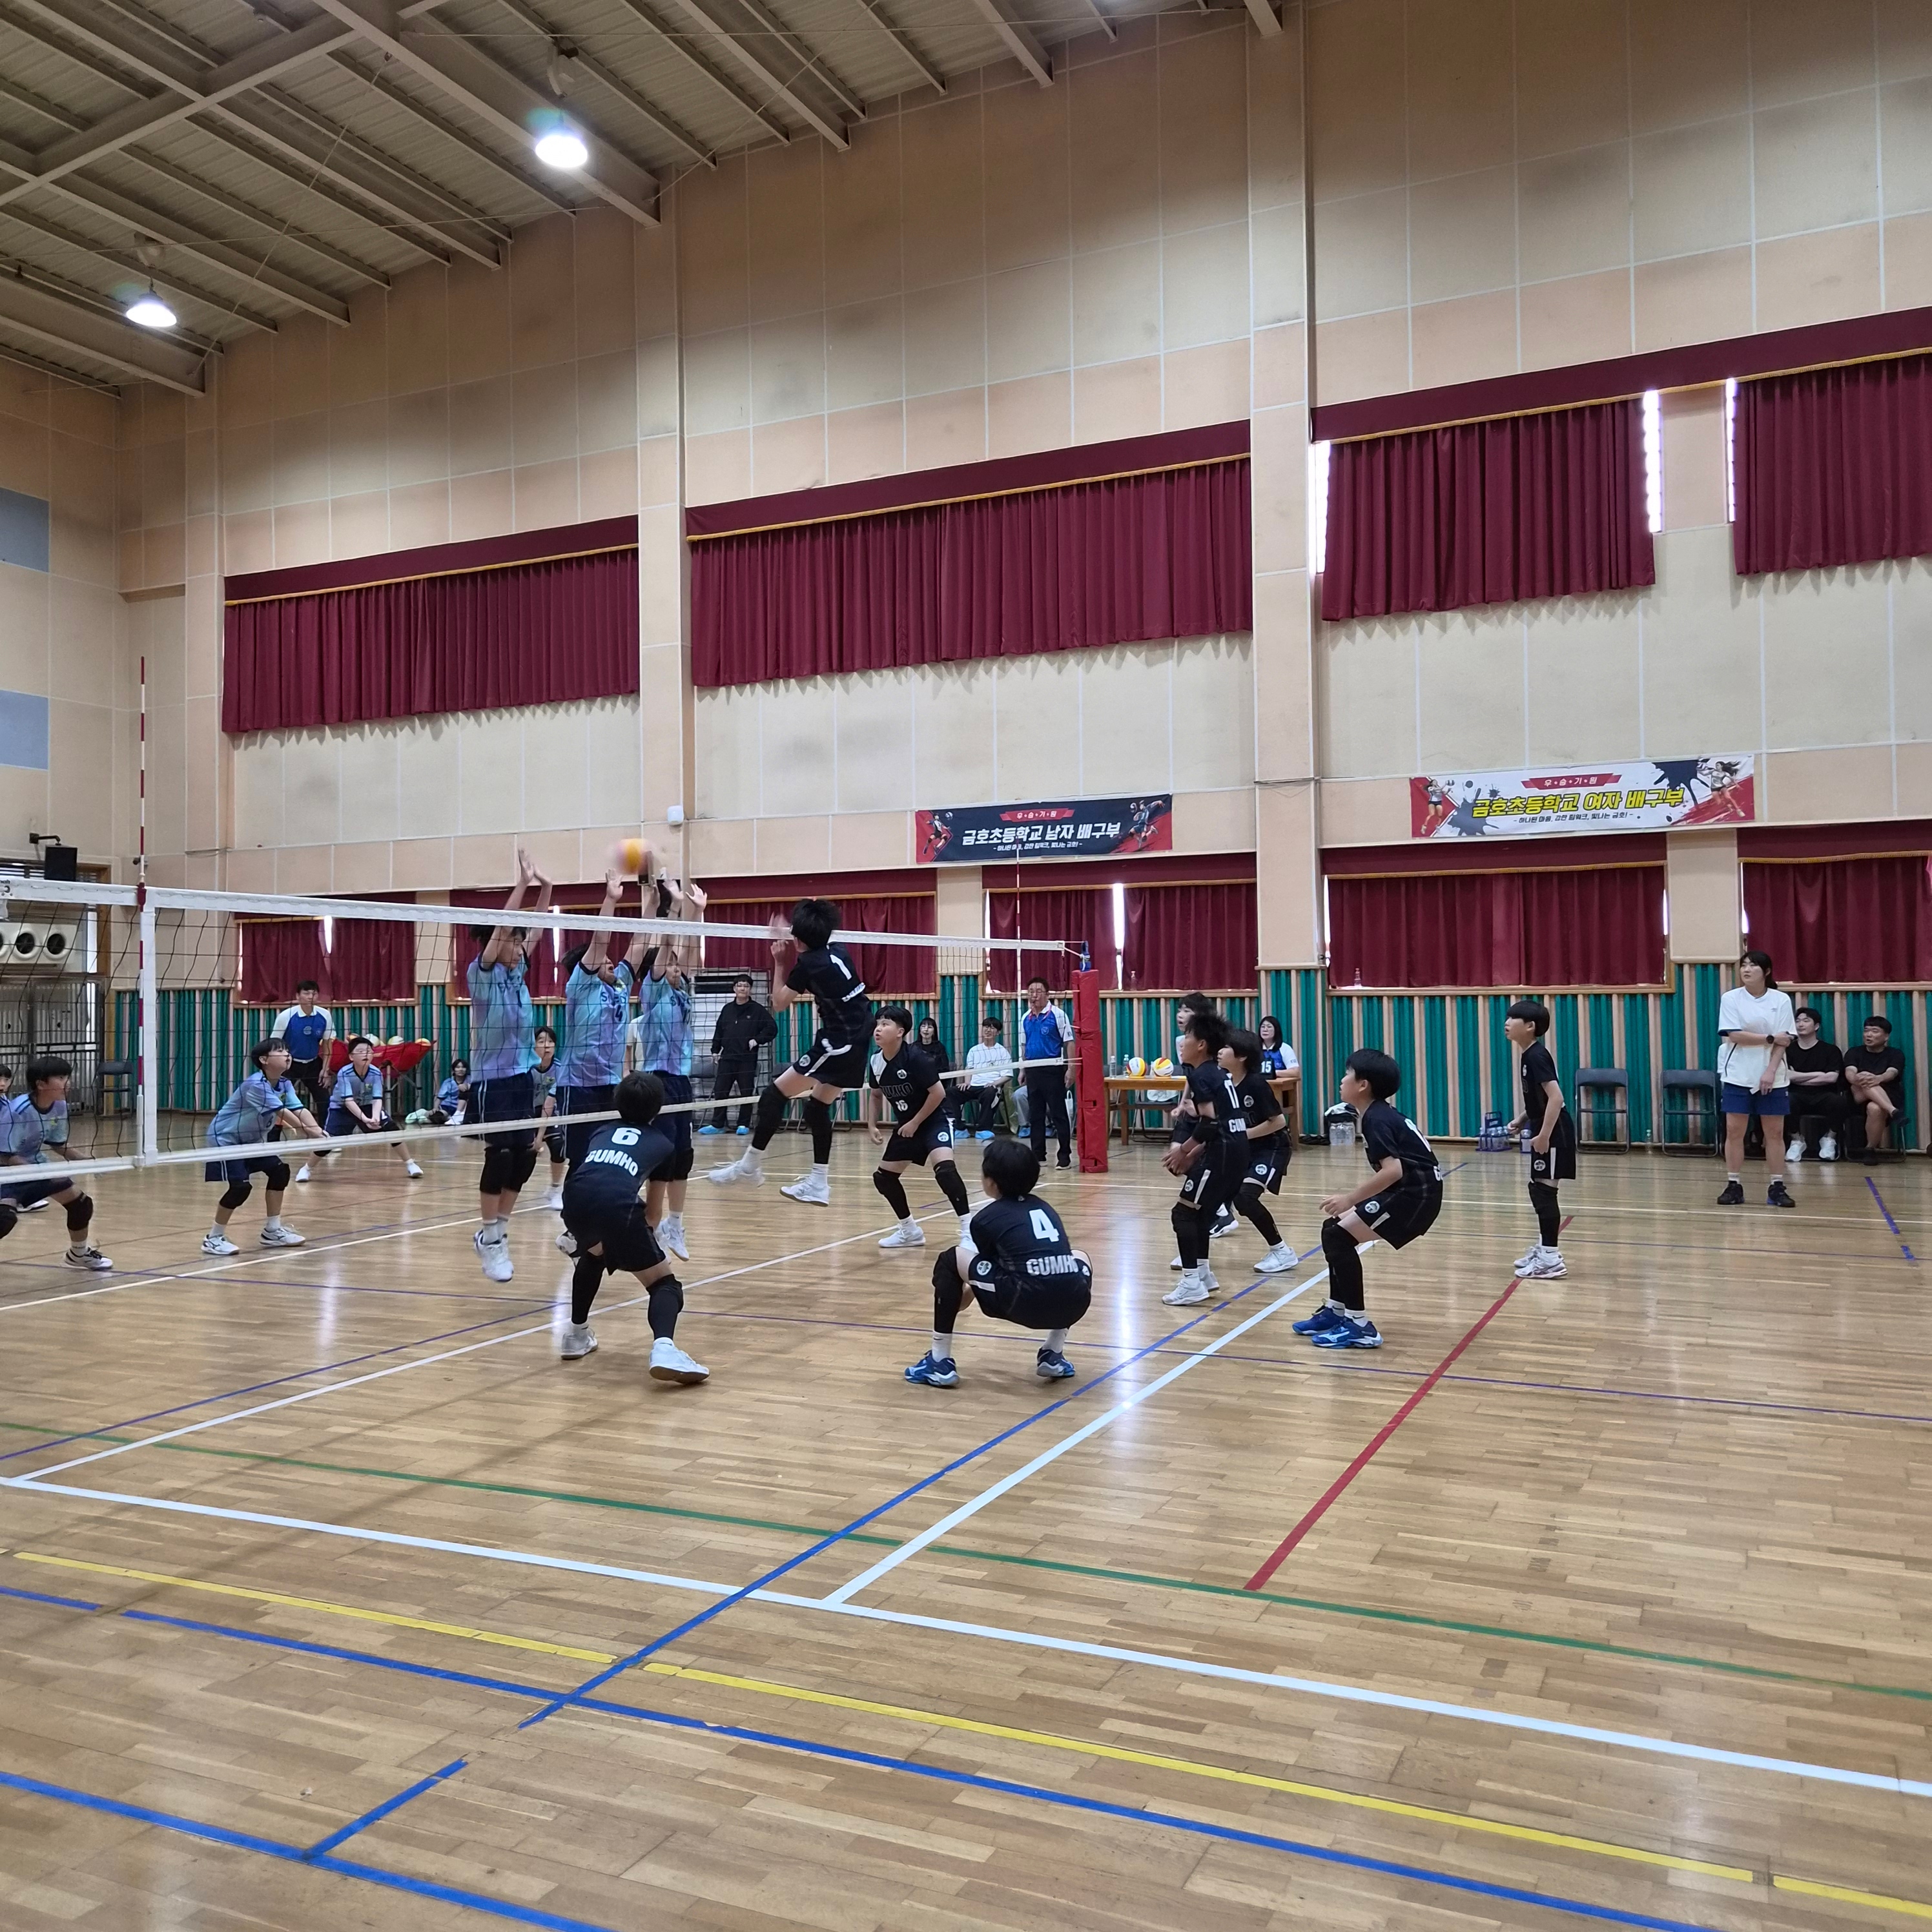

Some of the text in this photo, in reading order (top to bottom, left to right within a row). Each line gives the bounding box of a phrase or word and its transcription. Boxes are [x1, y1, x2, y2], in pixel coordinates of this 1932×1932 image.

[1472, 788, 1685, 818] 금호초등학교 여자 배구부
[962, 822, 1122, 846] 금호초등학교 남자 배구부
[830, 954, 852, 980] 1
[1261, 1061, 1272, 1073] 15
[611, 1127, 641, 1146] 6
[584, 1149, 639, 1177] GUMHO
[1029, 1209, 1060, 1242] 4
